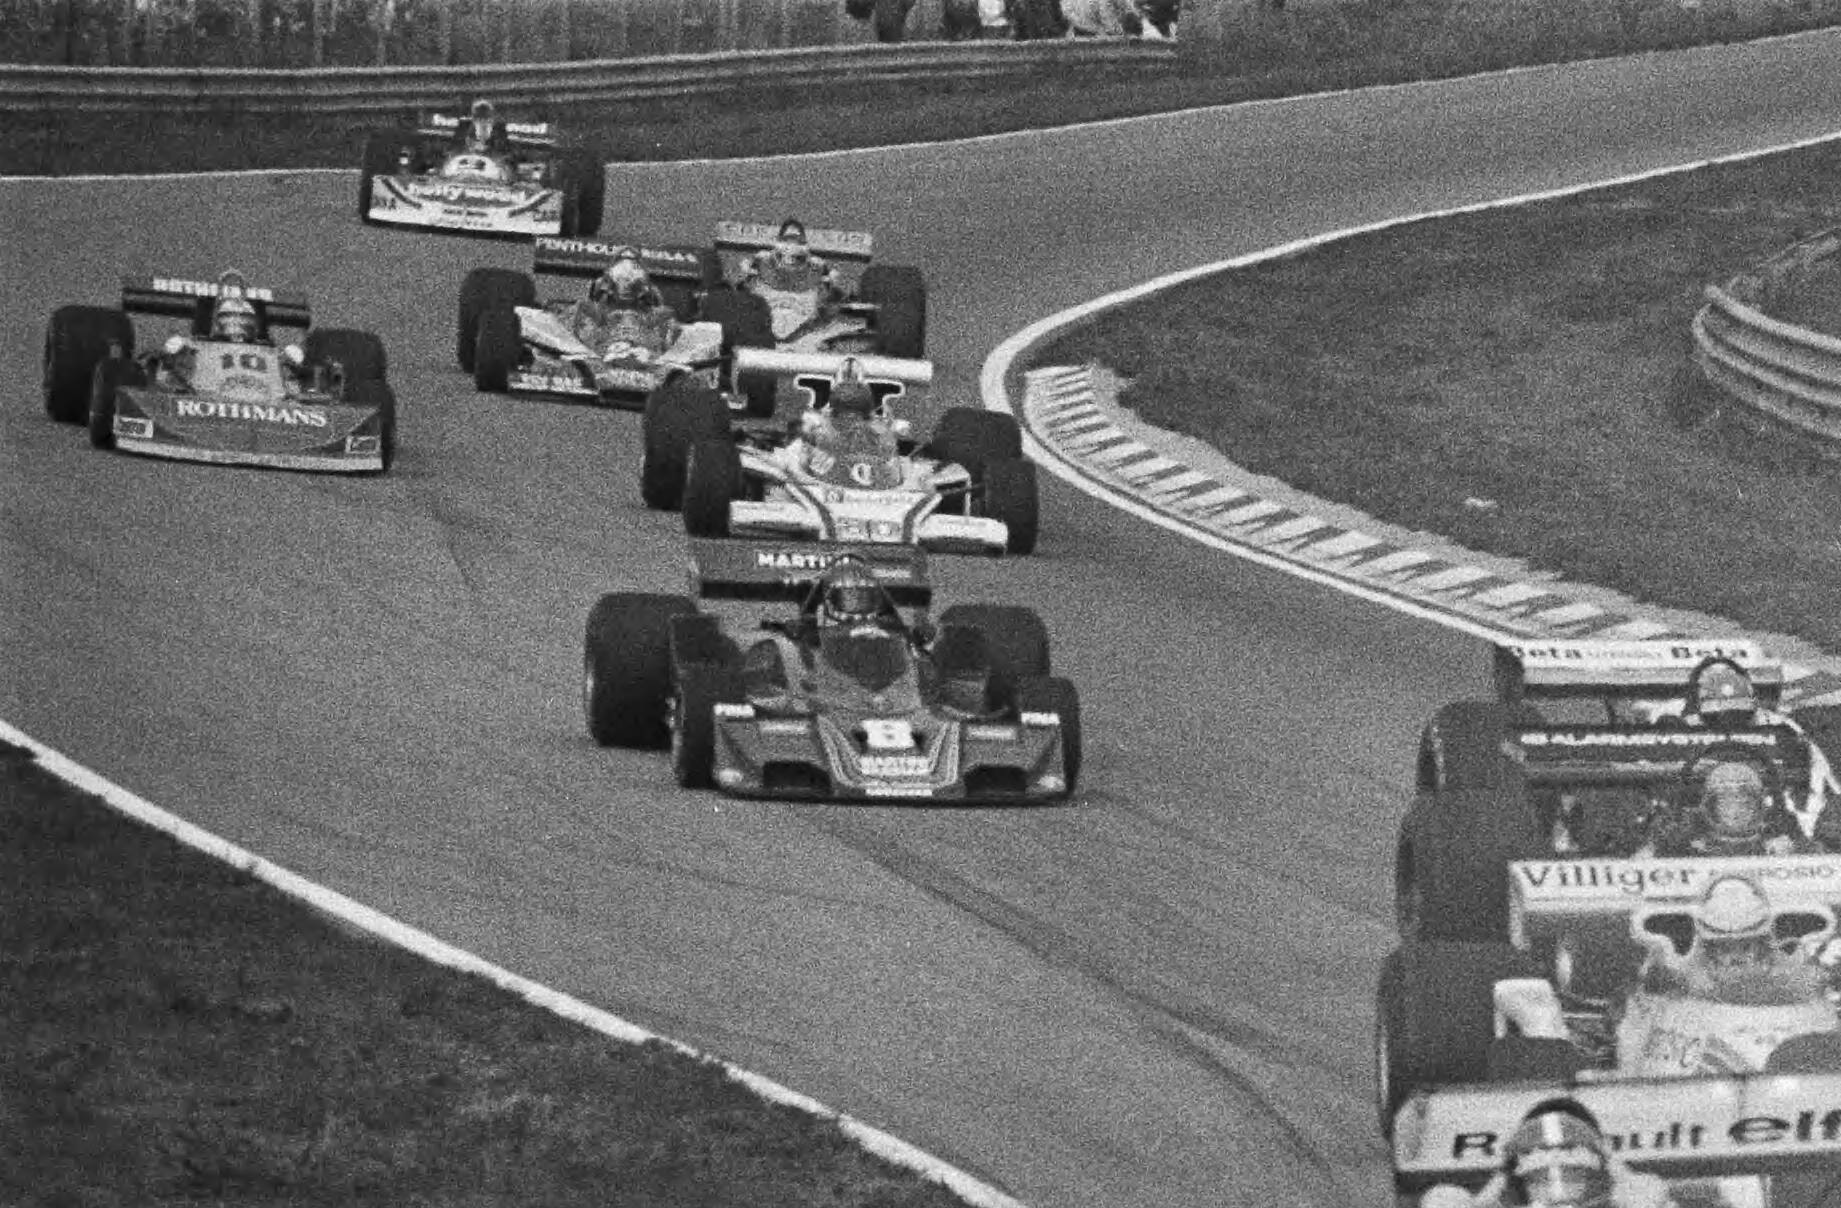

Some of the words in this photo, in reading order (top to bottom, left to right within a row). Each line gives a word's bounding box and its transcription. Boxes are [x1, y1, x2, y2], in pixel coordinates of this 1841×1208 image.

[175, 399, 328, 427] ROTHMANS
[757, 552, 851, 570] MARTI
[1521, 863, 1695, 894] Villiger
[1451, 1121, 1706, 1159] Rault
